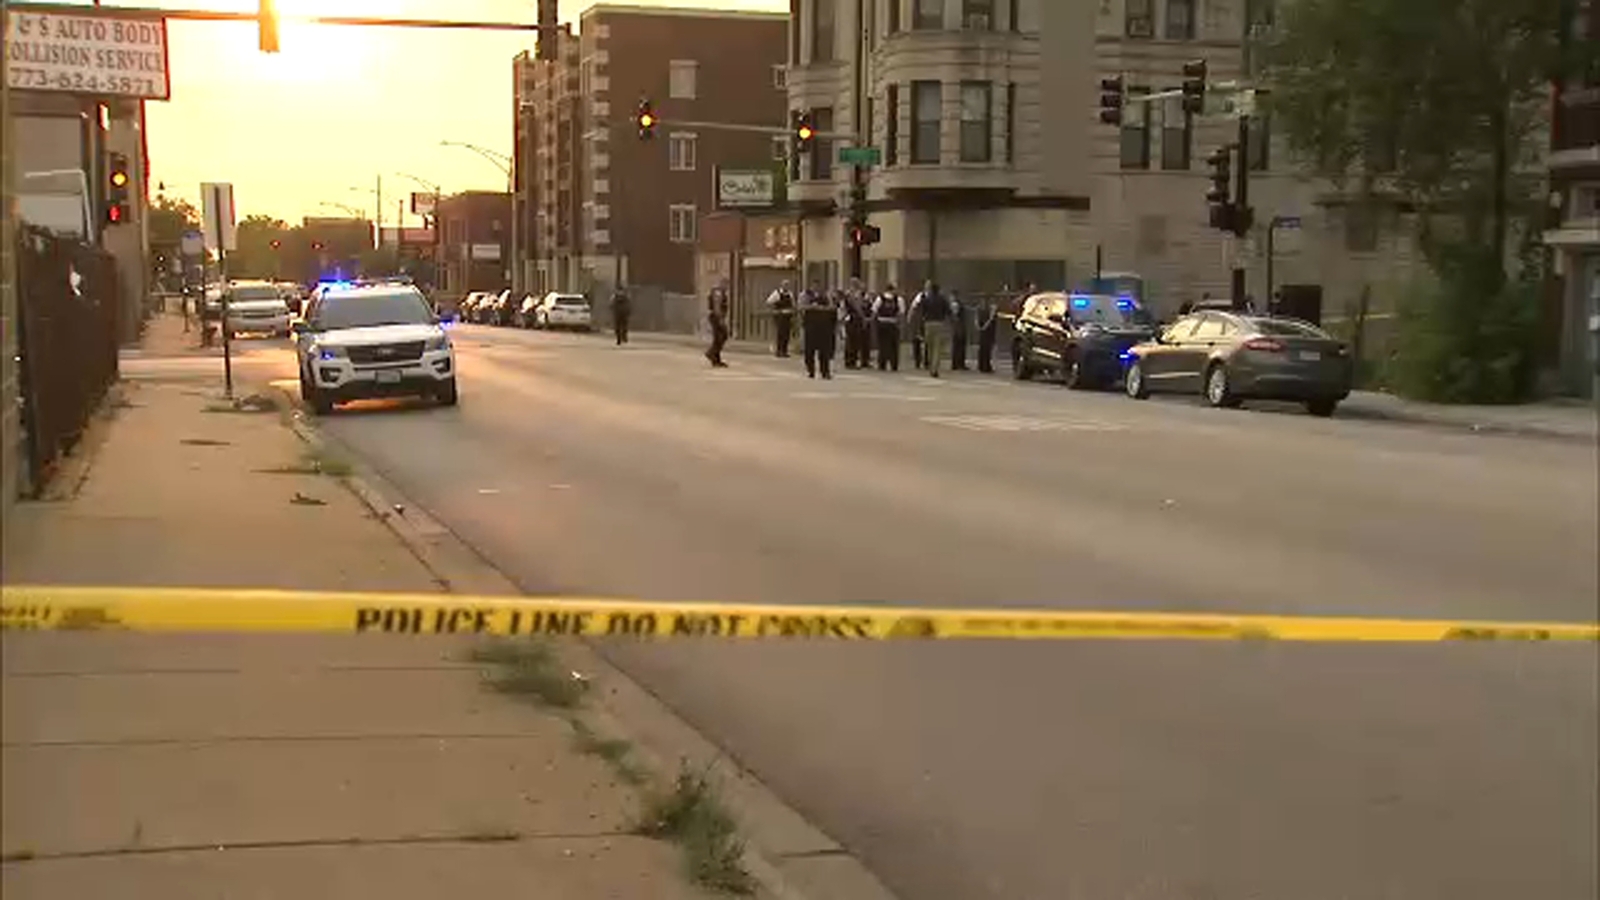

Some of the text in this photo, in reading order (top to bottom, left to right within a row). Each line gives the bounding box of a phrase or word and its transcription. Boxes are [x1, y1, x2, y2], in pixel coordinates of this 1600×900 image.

[39, 16, 50, 37] S
[56, 19, 106, 41] AUTO
[113, 21, 160, 46] BODY
[7, 41, 91, 68] OLLISION
[356, 608, 872, 640] POLICE LINE DO NOT CROSS
